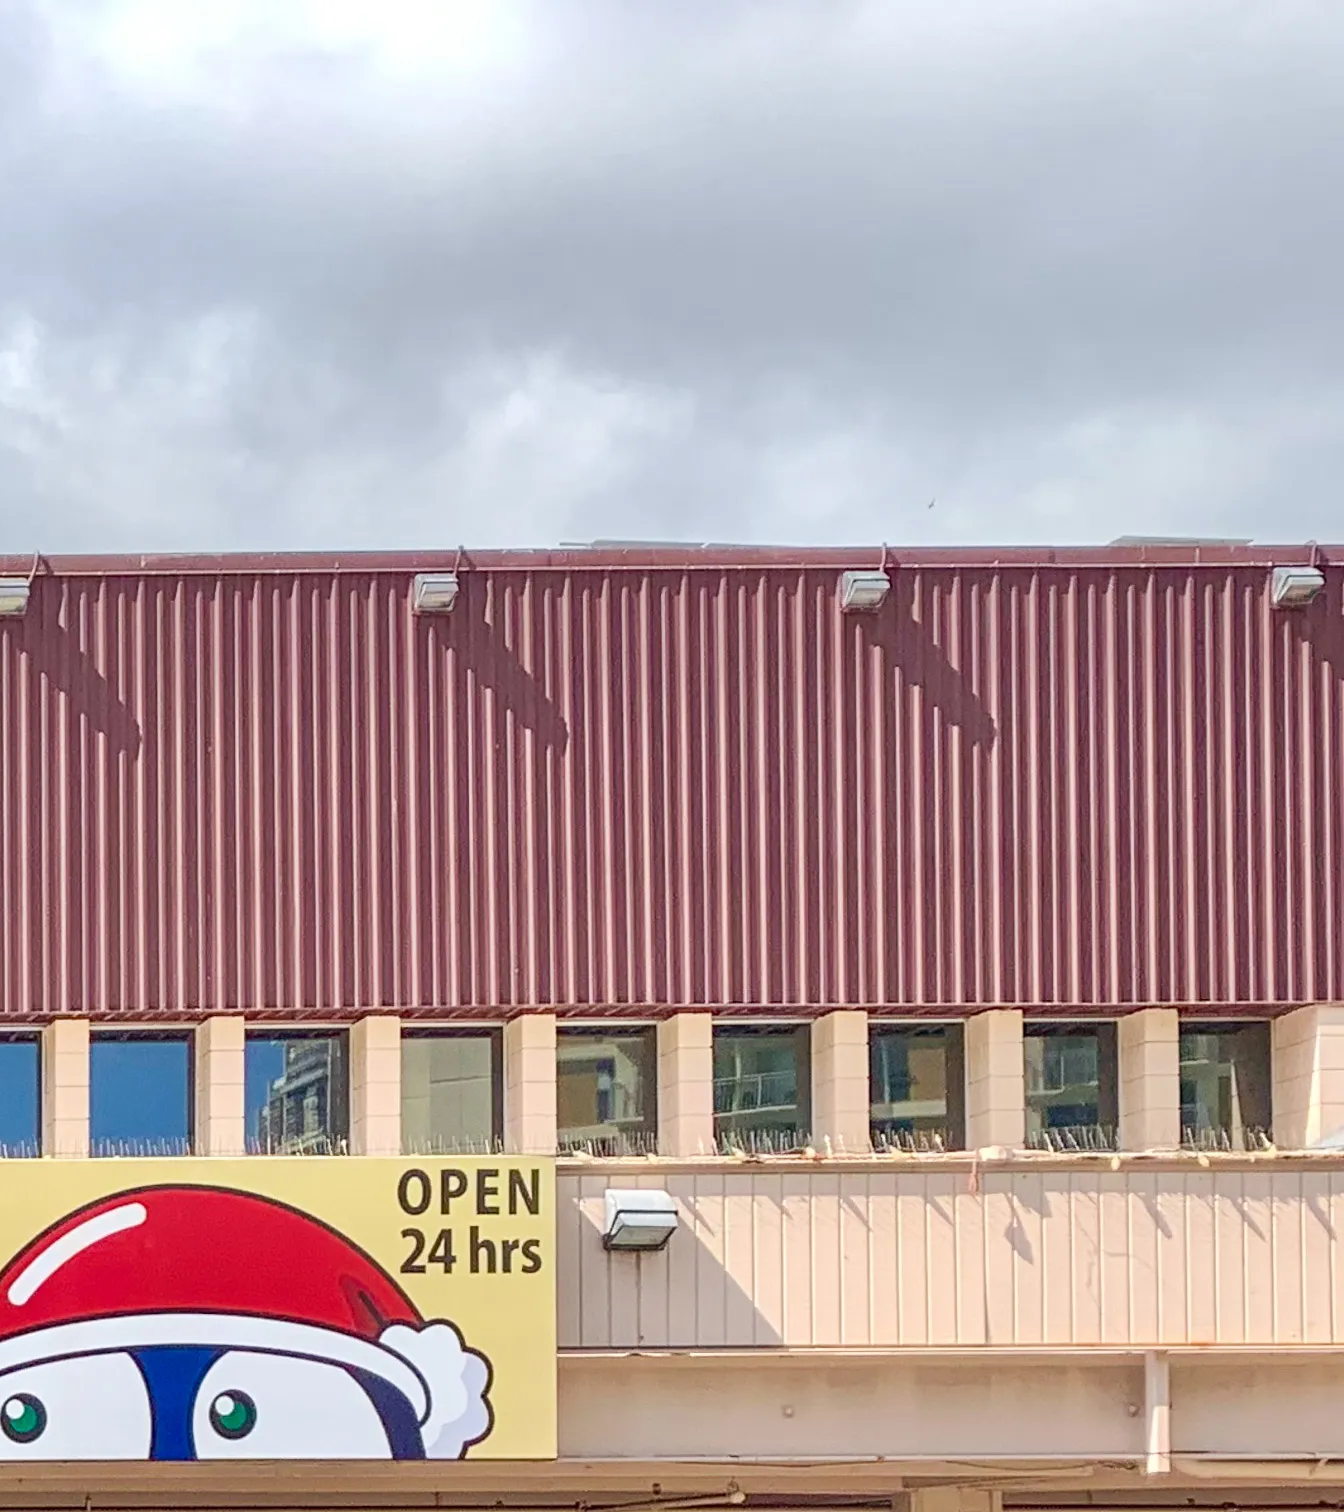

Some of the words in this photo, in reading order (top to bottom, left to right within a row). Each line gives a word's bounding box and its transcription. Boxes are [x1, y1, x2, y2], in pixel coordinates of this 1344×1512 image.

[398, 1169, 540, 1215] OPEN
[400, 1227, 457, 1274] 24
[469, 1226, 542, 1274] hrs
